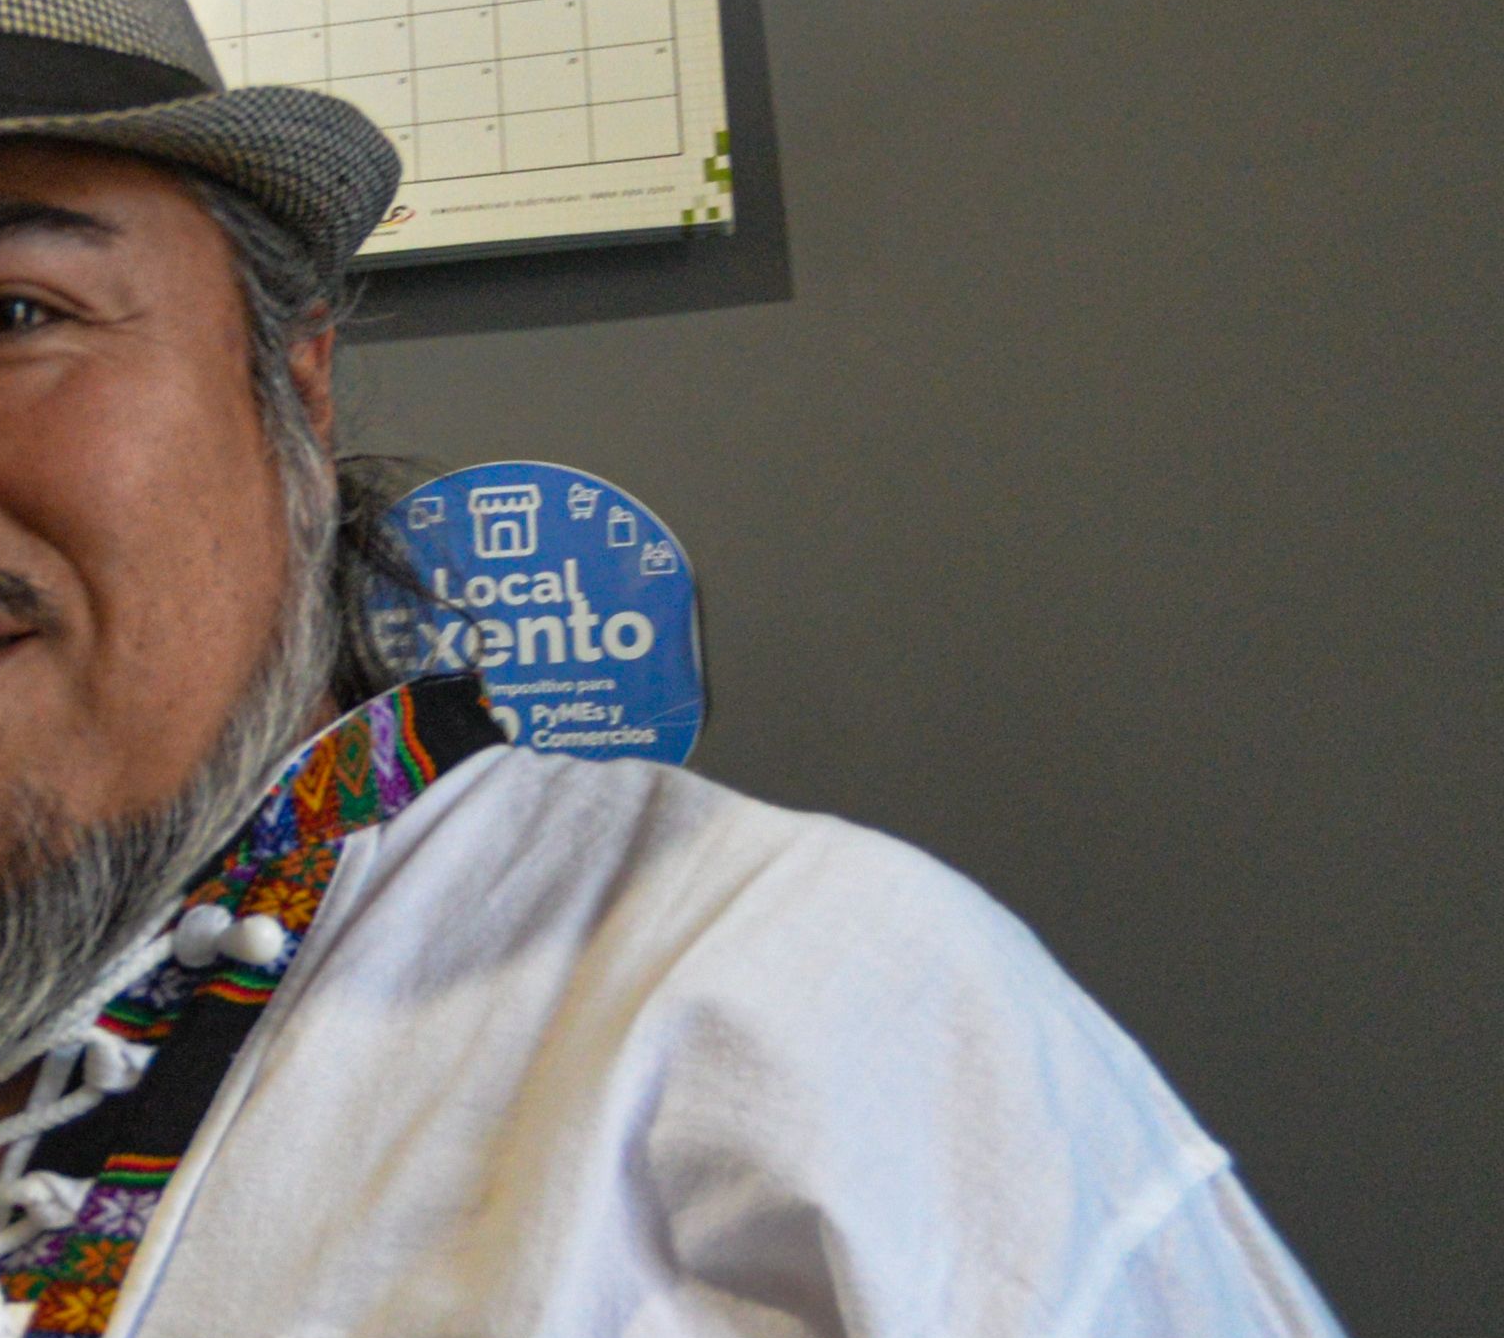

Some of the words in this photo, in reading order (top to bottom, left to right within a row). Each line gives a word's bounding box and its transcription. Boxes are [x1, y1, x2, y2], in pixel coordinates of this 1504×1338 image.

[434, 558, 586, 609] Local
[370, 598, 654, 670] Exento
[576, 678, 617, 696] para
[531, 701, 606, 728] PyMEs
[608, 704, 624, 726] y
[531, 724, 658, 749] Comercios
